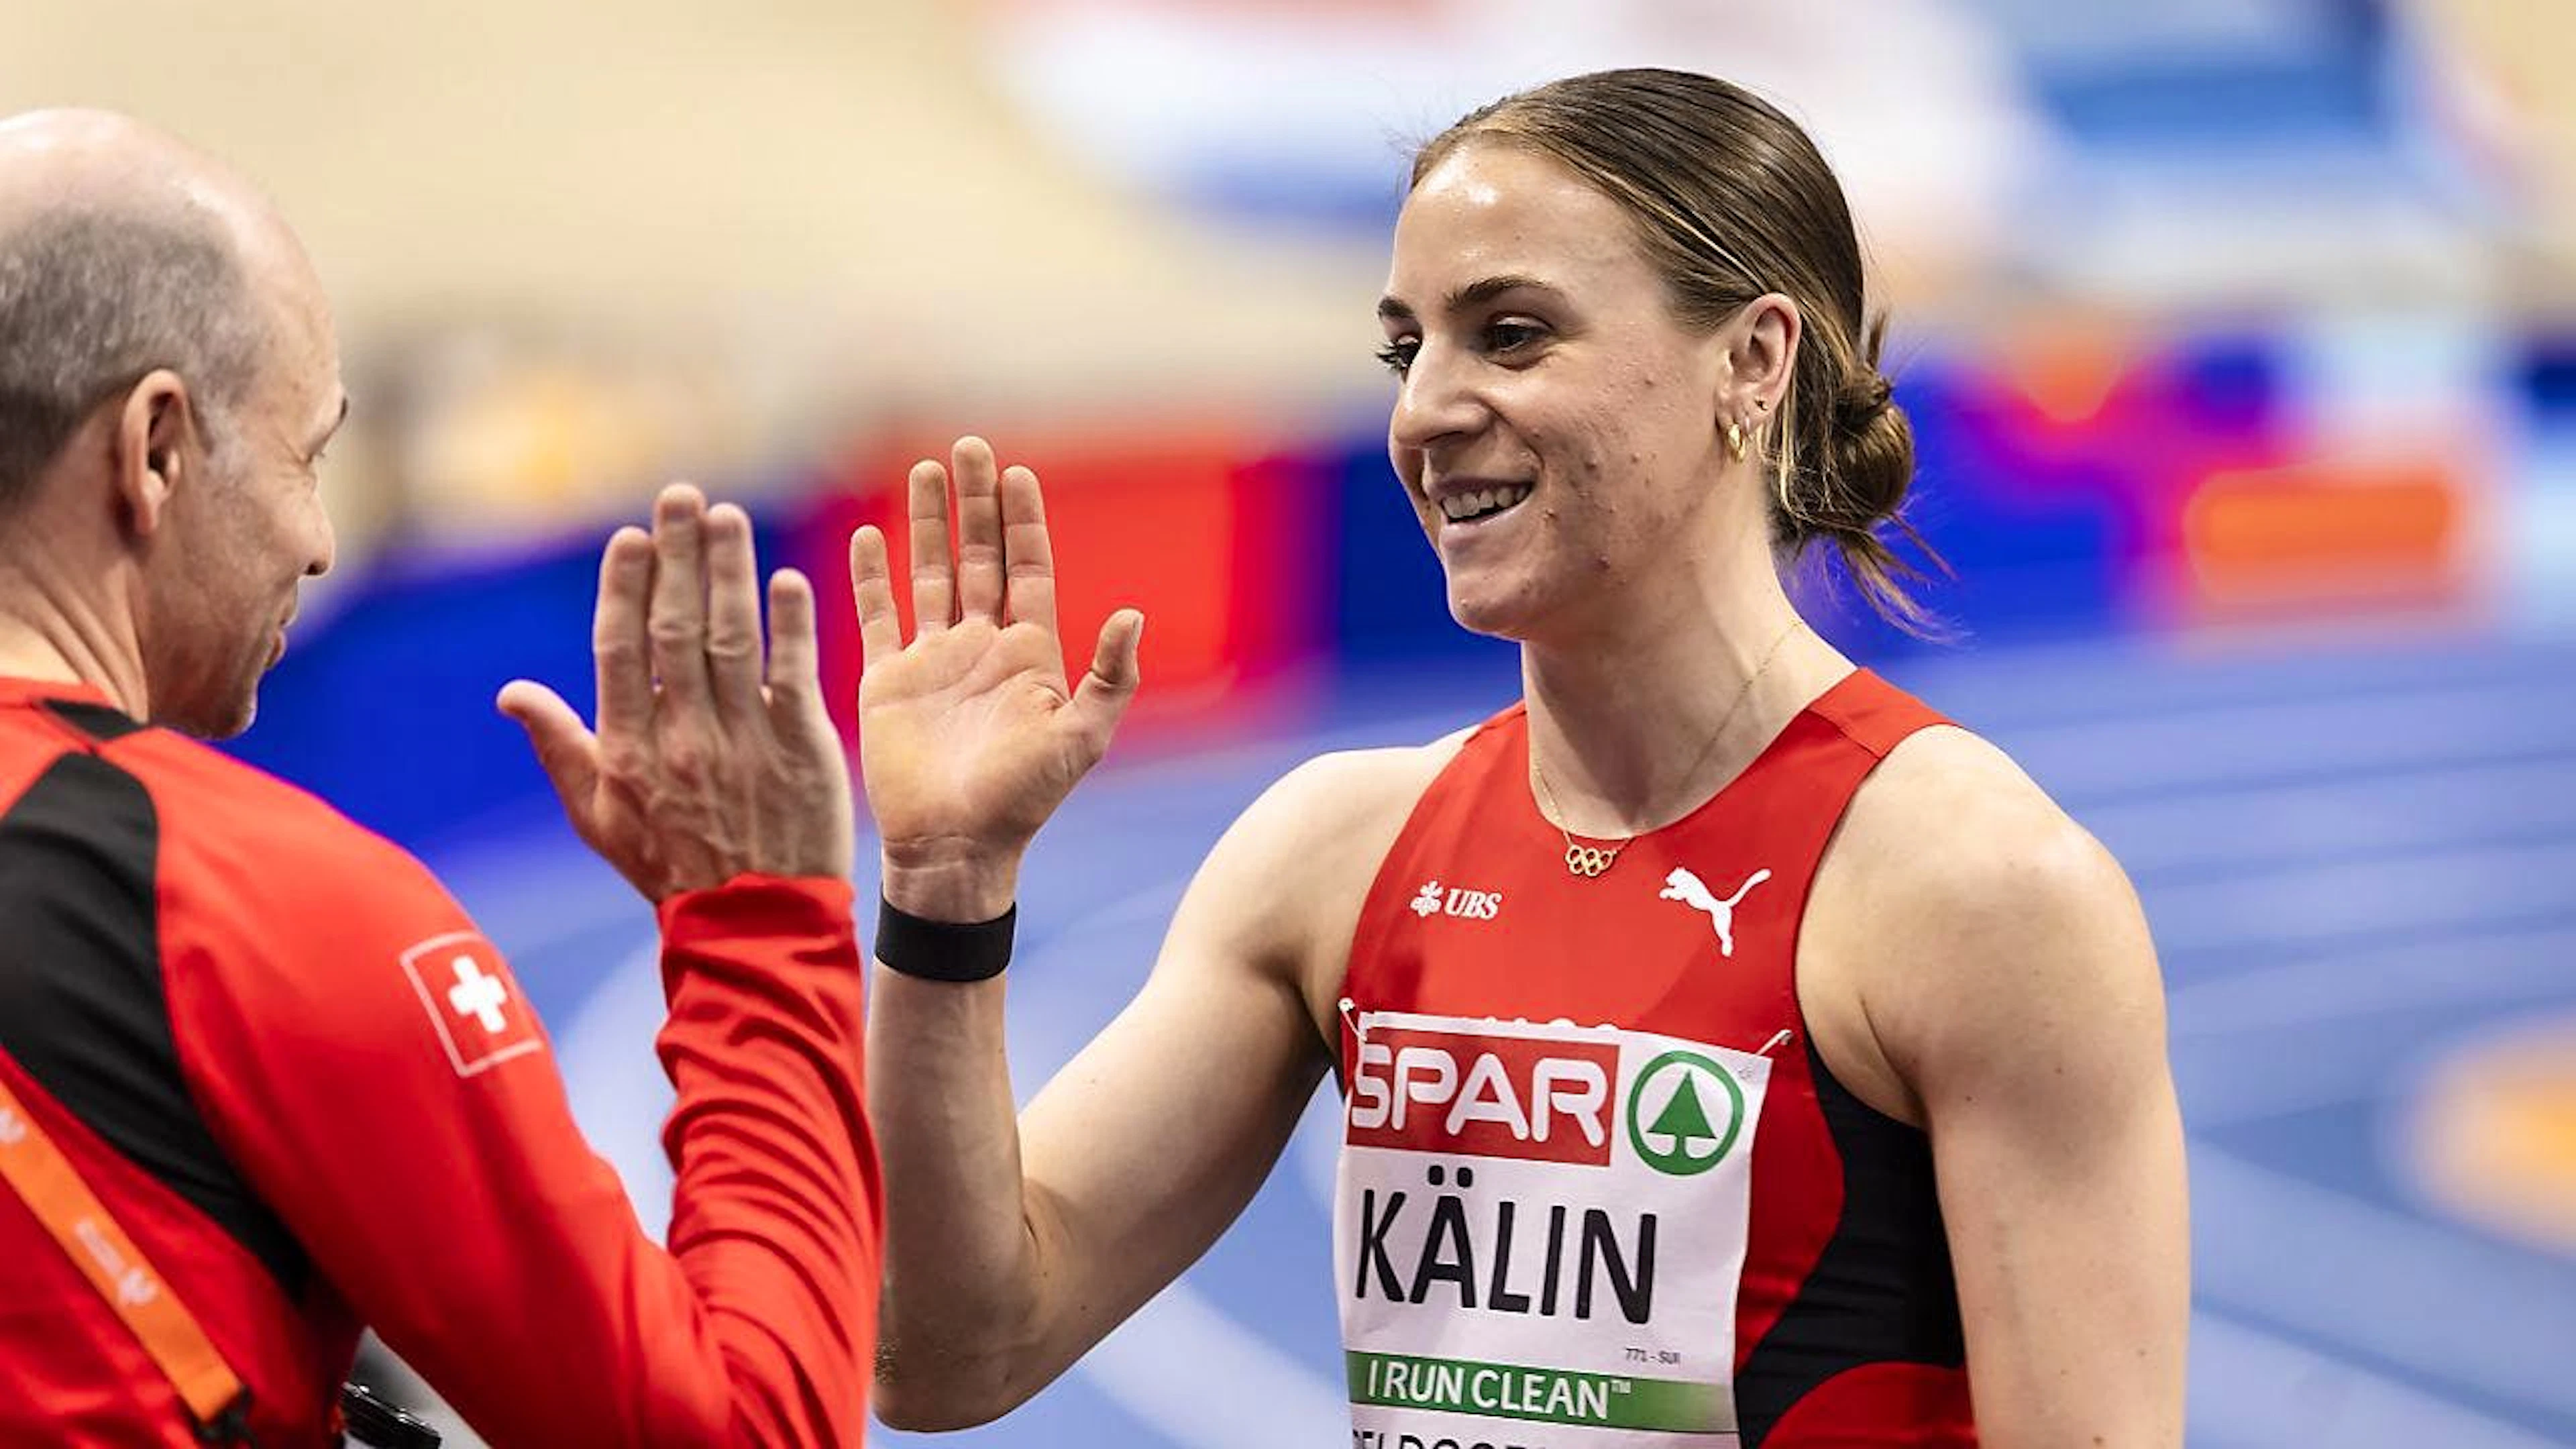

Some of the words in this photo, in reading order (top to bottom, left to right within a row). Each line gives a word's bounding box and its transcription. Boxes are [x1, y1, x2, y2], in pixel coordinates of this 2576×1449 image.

[1444, 888, 1503, 920] UBS
[1350, 1044, 1608, 1148] SPAR
[1356, 1165, 1657, 1325] KÄLIN
[1367, 1359, 1378, 1397] I
[1383, 1361, 1465, 1405] RUN
